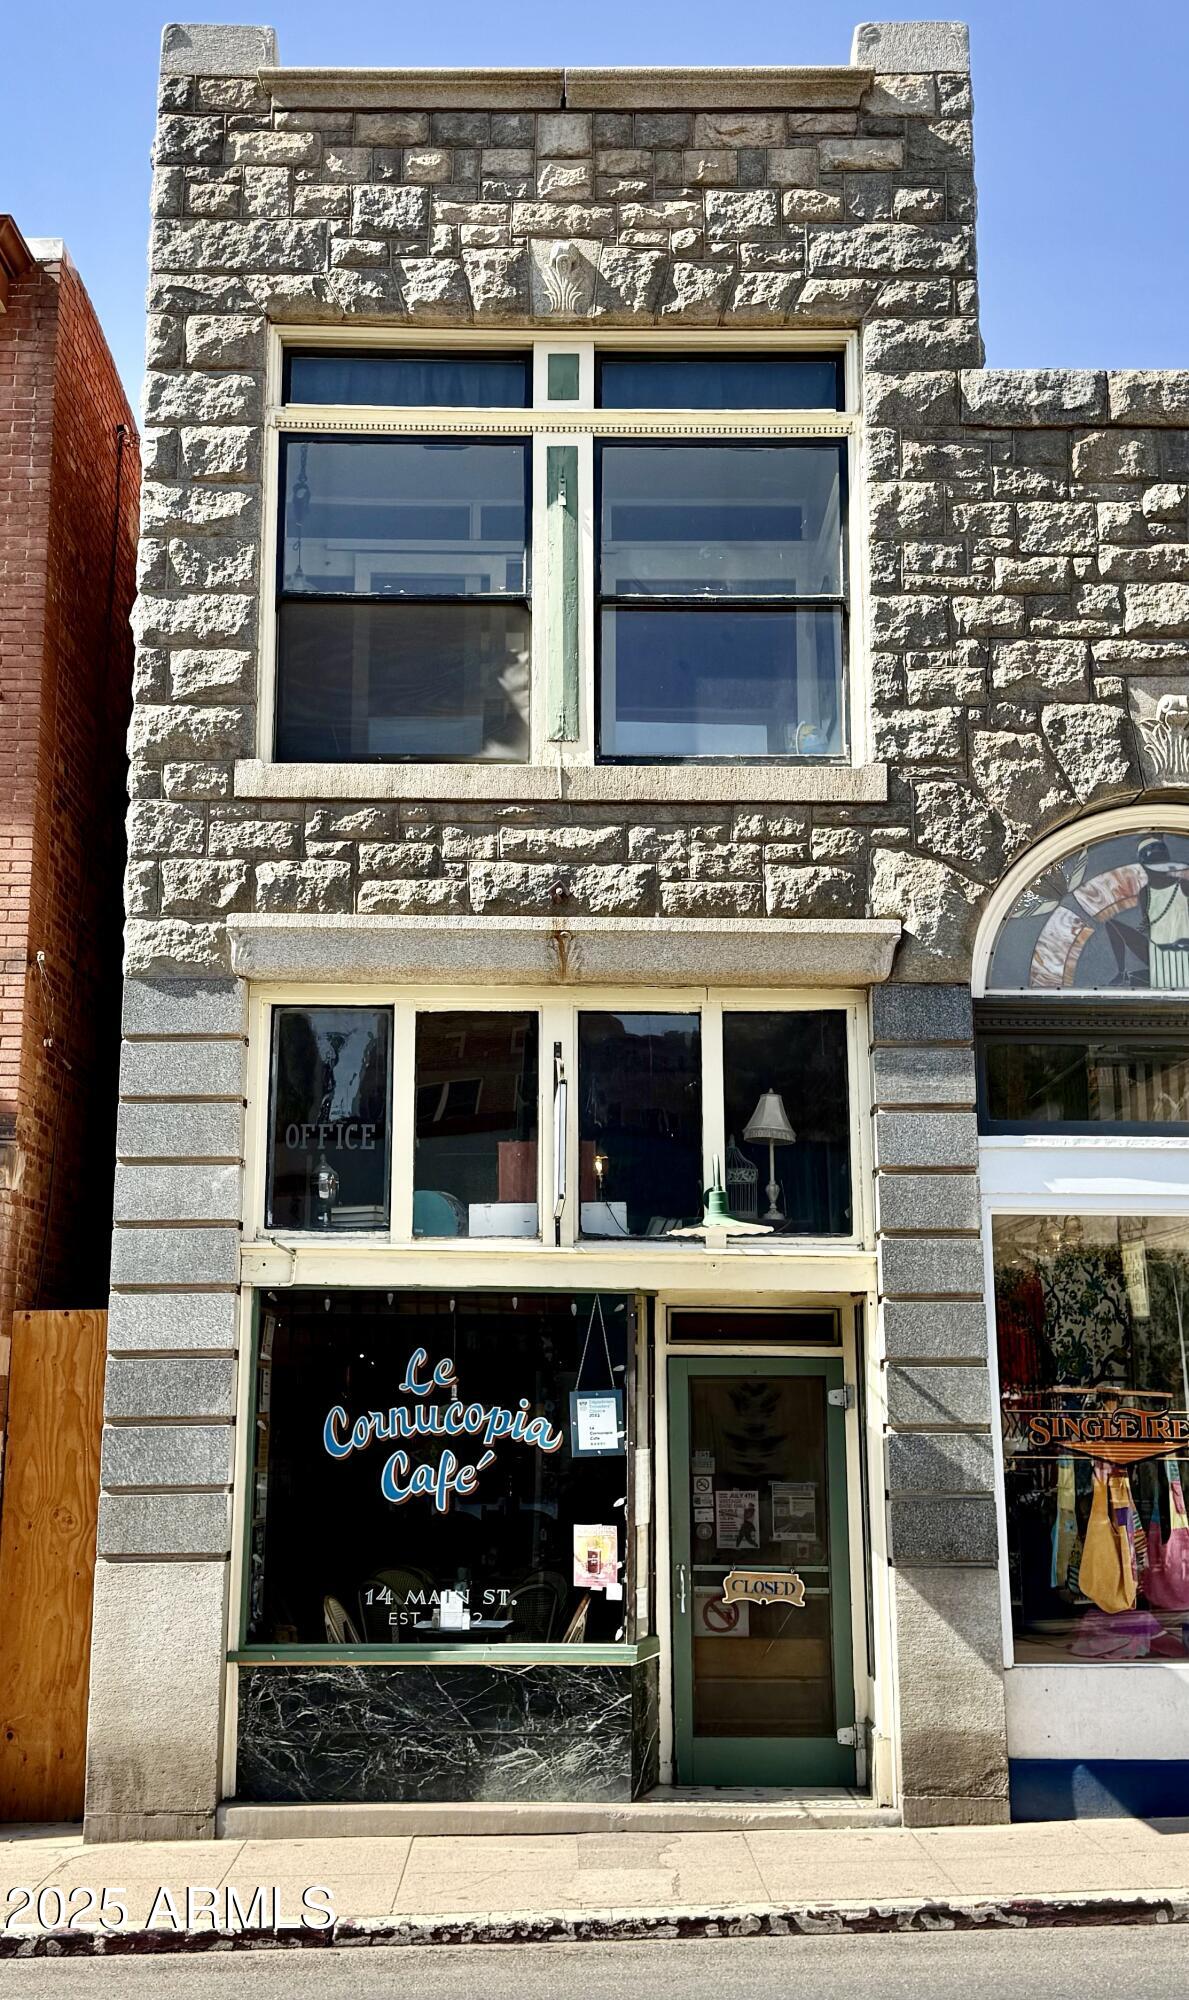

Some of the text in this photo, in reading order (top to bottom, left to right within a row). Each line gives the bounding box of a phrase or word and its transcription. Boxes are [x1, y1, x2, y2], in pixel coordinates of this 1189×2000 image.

[285, 1123, 376, 1150] OFFICE
[399, 1347, 459, 1397] Le
[323, 1398, 563, 1460] Cornucopia
[381, 1449, 497, 1514] Café
[365, 1585, 518, 1606] 14 MAIN ST.
[731, 1579, 796, 1597] CLOSED
